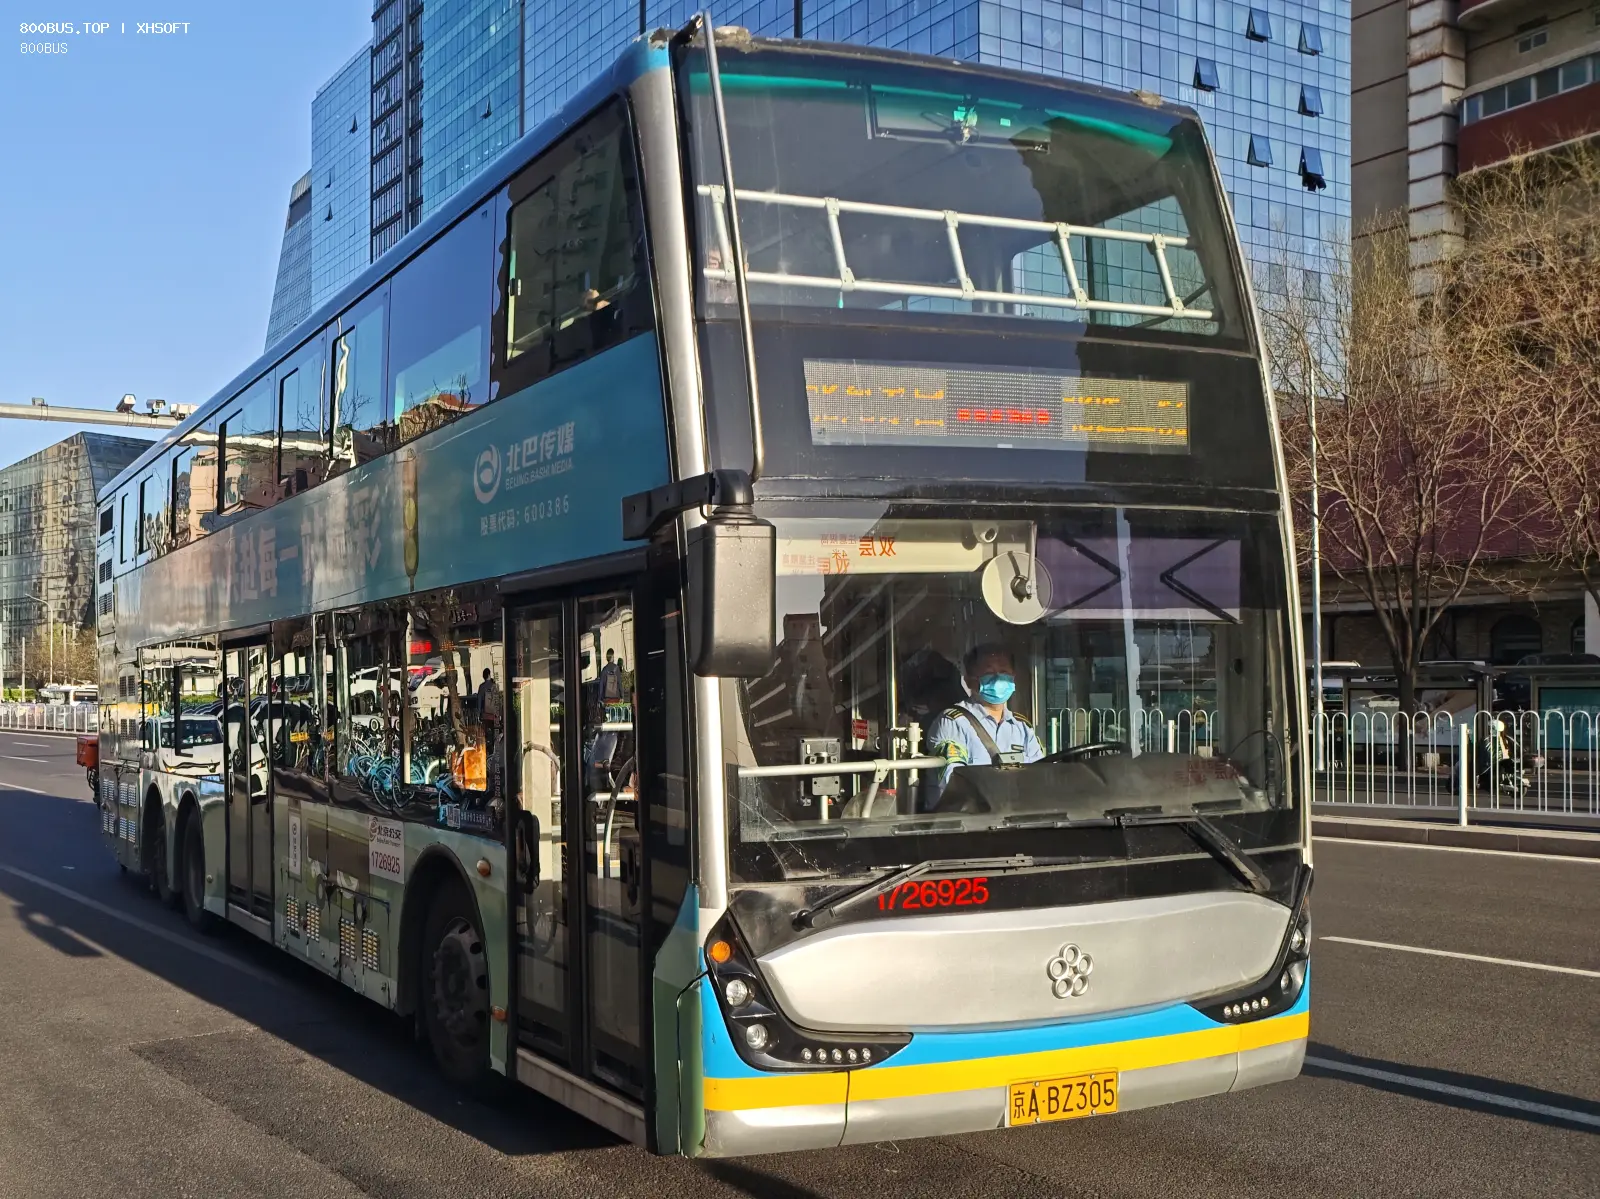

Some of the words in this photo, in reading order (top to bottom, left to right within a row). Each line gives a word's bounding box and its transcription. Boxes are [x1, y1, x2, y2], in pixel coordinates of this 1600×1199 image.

[506, 422, 575, 472] 北巴传媒
[377, 825, 402, 841] 北京公交
[371, 850, 401, 875] 1726925
